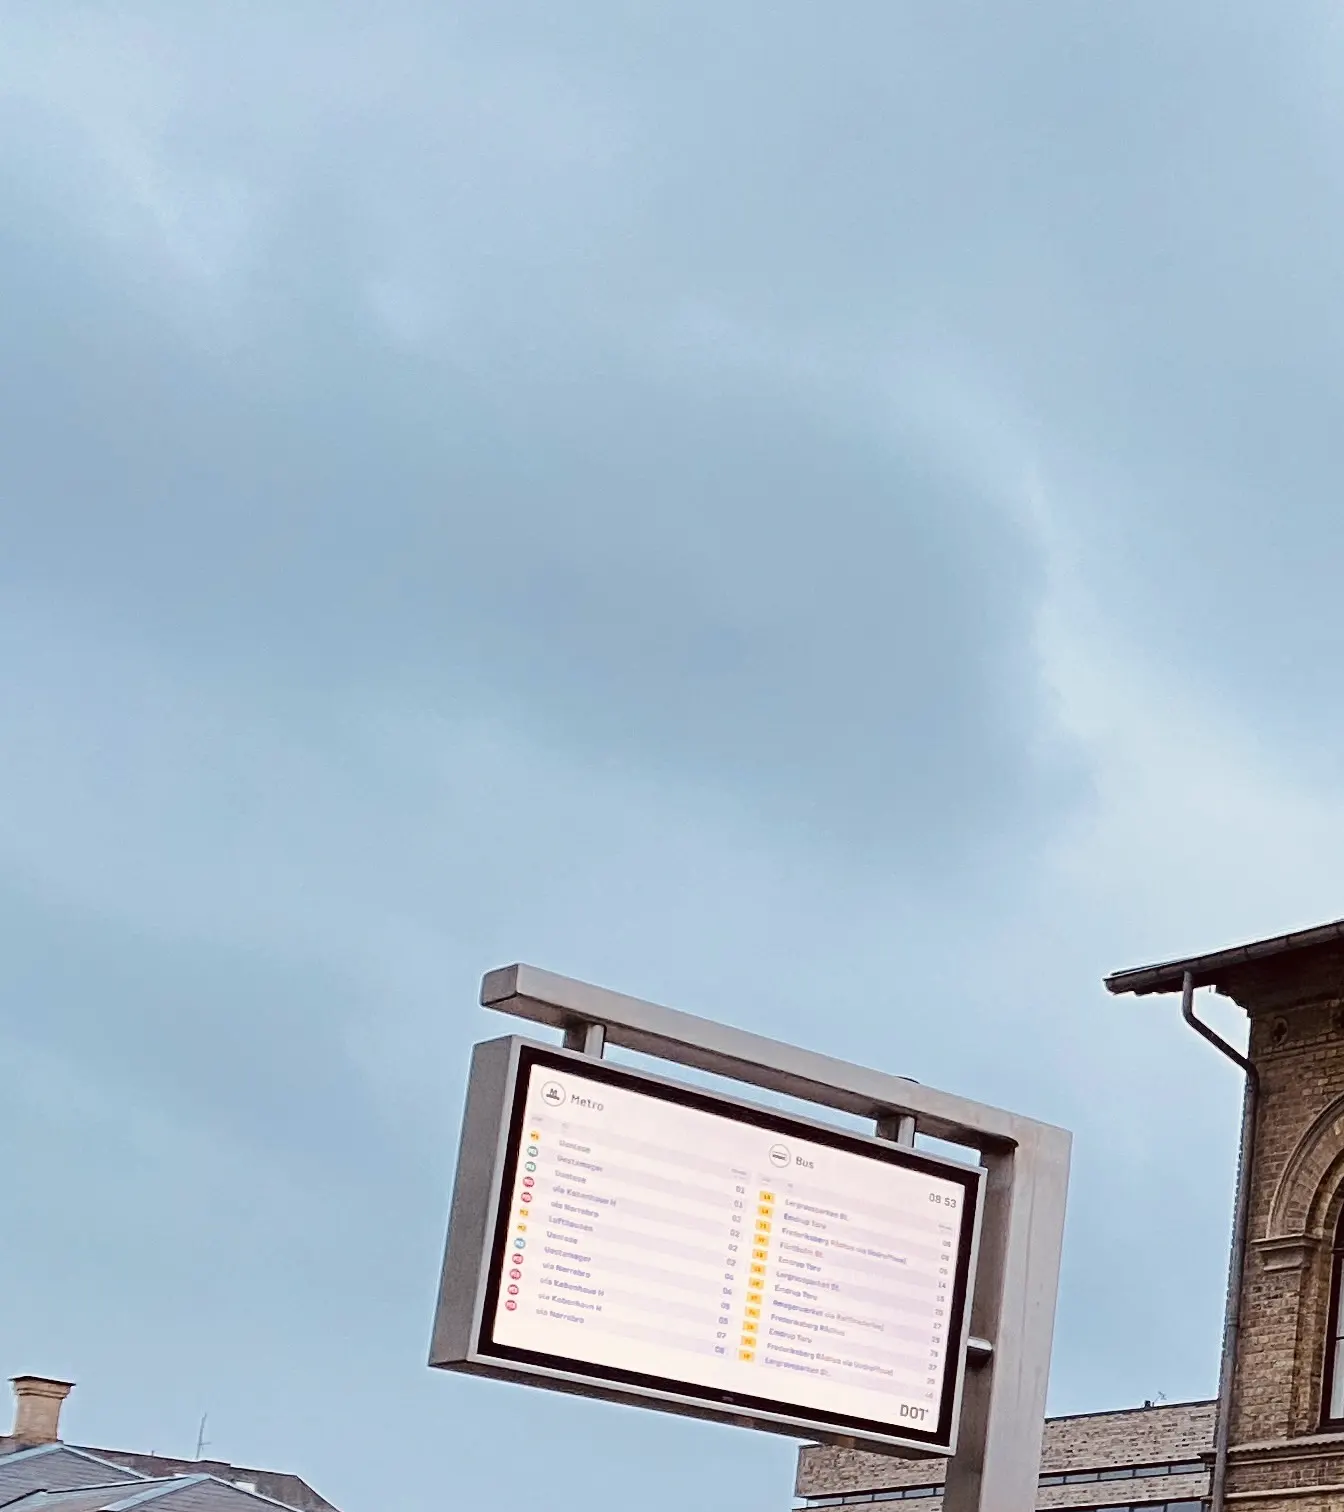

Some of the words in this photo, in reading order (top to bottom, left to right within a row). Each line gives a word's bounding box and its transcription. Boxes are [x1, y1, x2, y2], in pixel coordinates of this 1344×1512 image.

[570, 1093, 604, 1112] Metro
[795, 1156, 814, 1170] Bus
[899, 1403, 925, 1421] DOT
